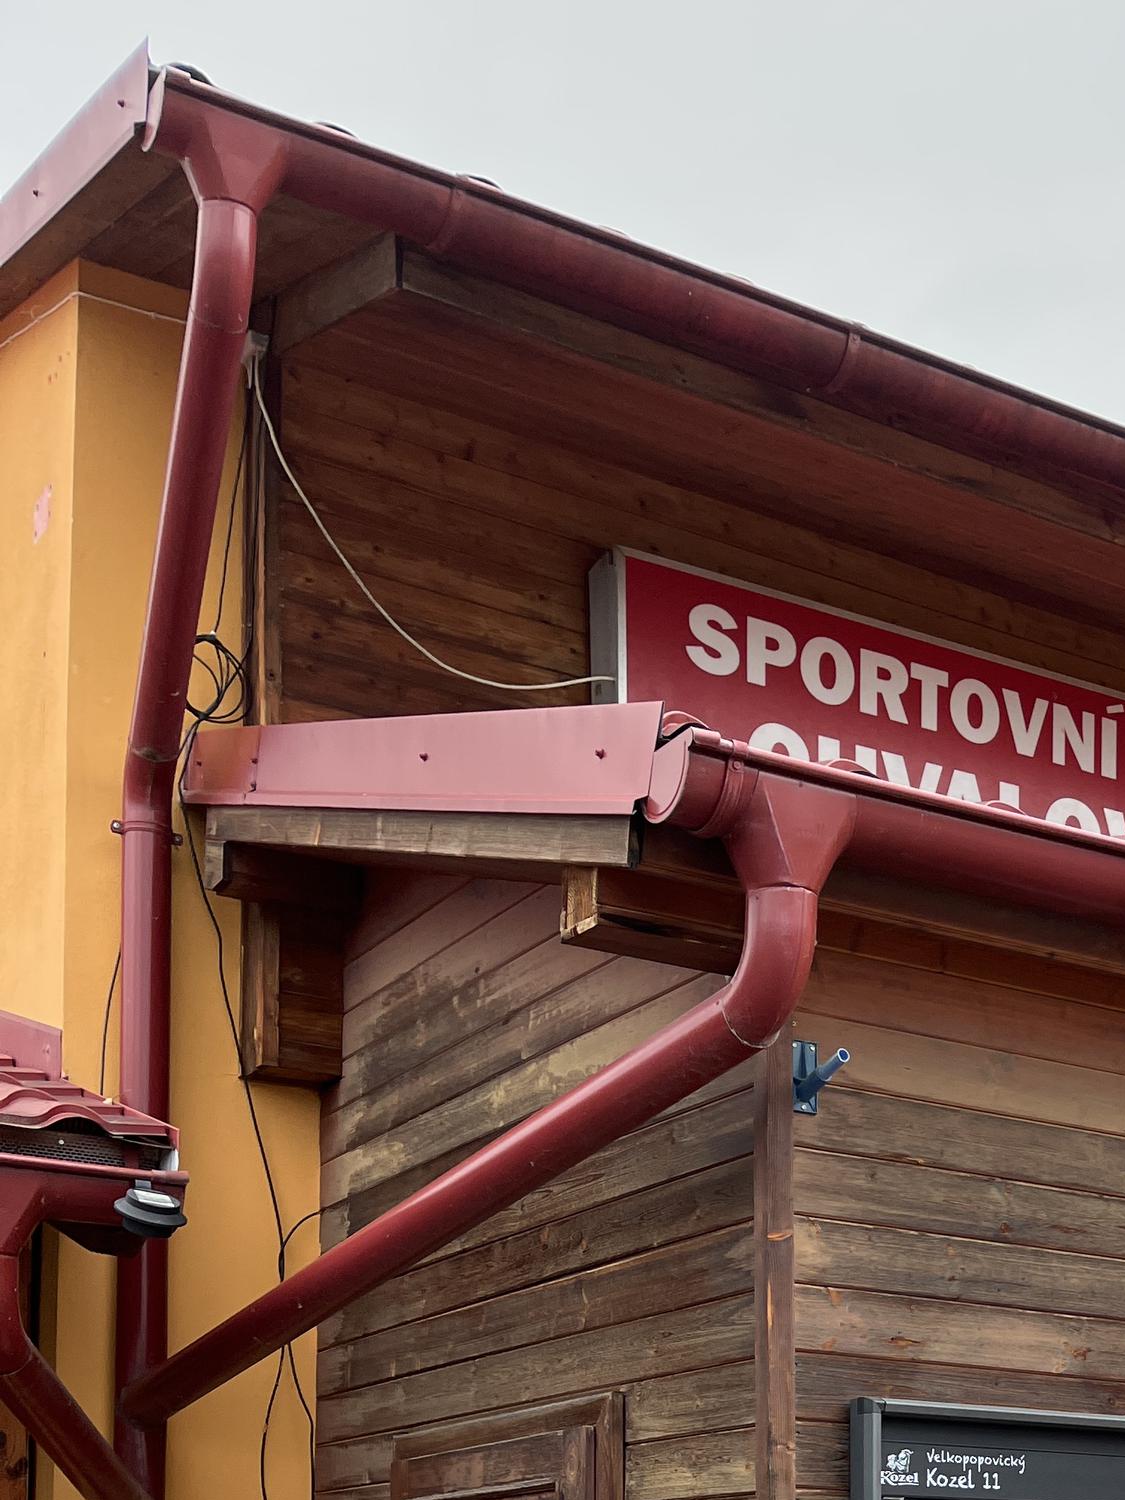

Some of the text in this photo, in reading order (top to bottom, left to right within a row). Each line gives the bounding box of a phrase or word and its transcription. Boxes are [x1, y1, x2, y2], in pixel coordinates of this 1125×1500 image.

[685, 603, 1124, 780] SPORTOVNÍ
[926, 1448, 1026, 1475] Velkopopovický
[881, 1470, 920, 1486] Kozel
[926, 1467, 1001, 1490] Kozel 11
